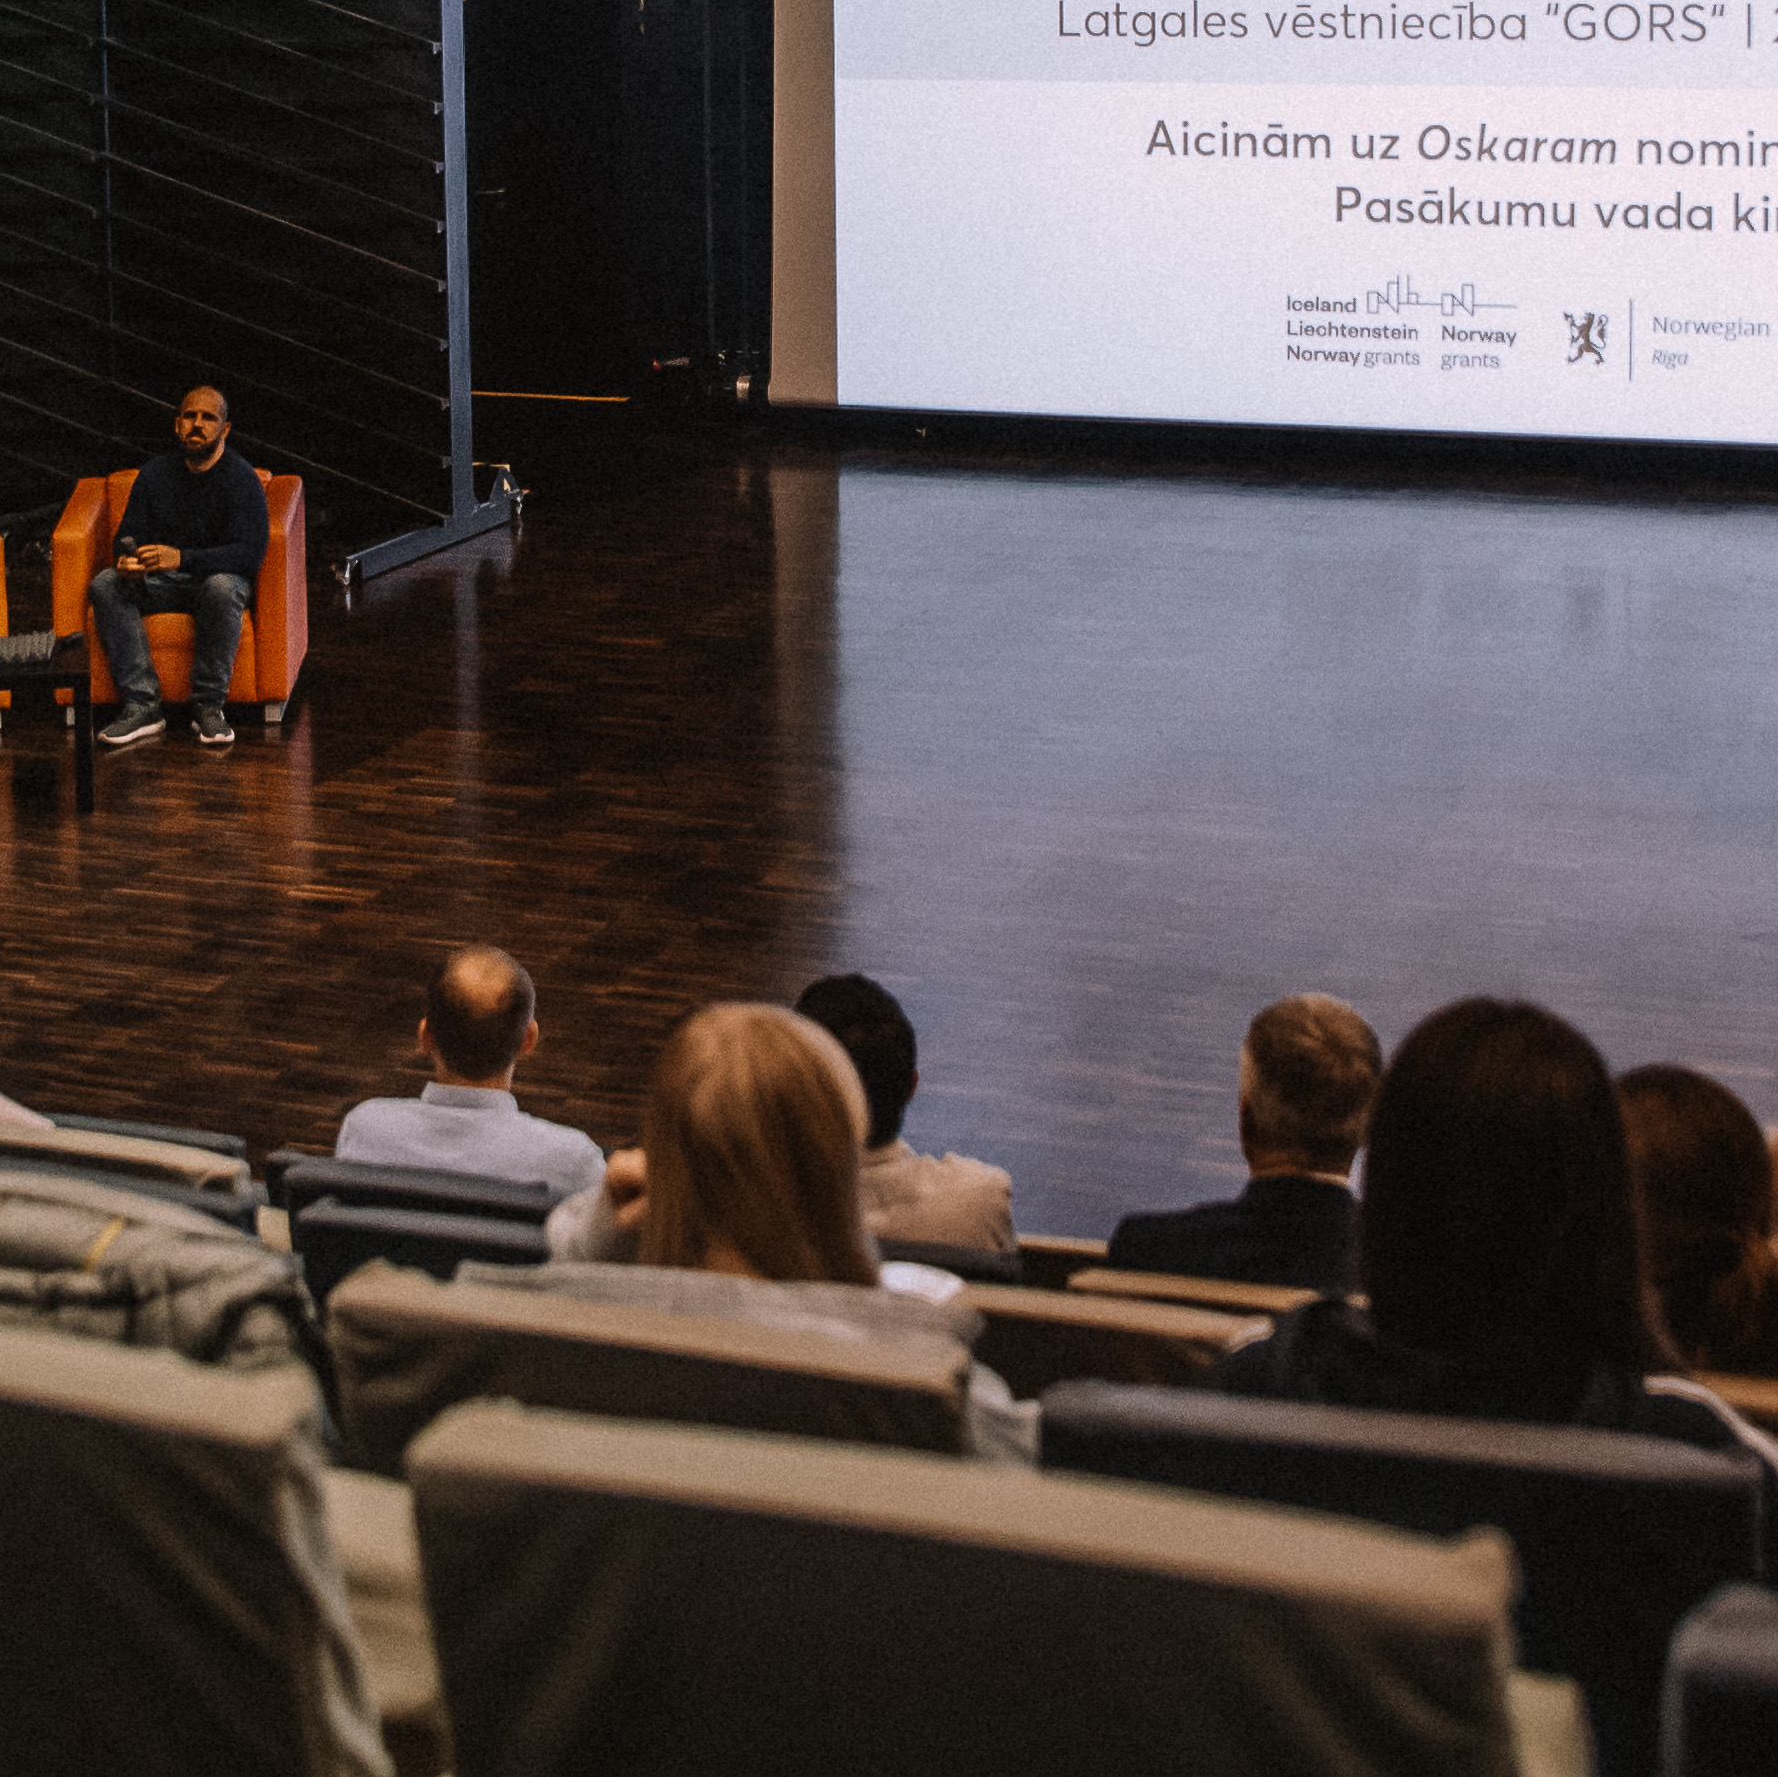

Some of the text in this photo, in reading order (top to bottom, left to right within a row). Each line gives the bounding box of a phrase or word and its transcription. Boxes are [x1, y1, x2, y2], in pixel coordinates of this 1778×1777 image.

[1057, 0, 1249, 48] Latgales
[1264, 0, 1527, 42] vēstniecība
[1145, 118, 1332, 159] Aicinām
[1351, 134, 1400, 161] uz
[1417, 122, 1617, 165] Oskaram
[1335, 185, 1576, 228] Pasākumu
[1594, 191, 1714, 231] vada
[1286, 295, 1357, 314] Iceland
[1286, 319, 1419, 341] Liechtenstein
[1441, 325, 1518, 348] Norway
[1652, 315, 1771, 342] Norwegian
[1286, 344, 1421, 369] Norway grants
[1440, 353, 1501, 371] grants
[1651, 348, 1690, 370] Riga
